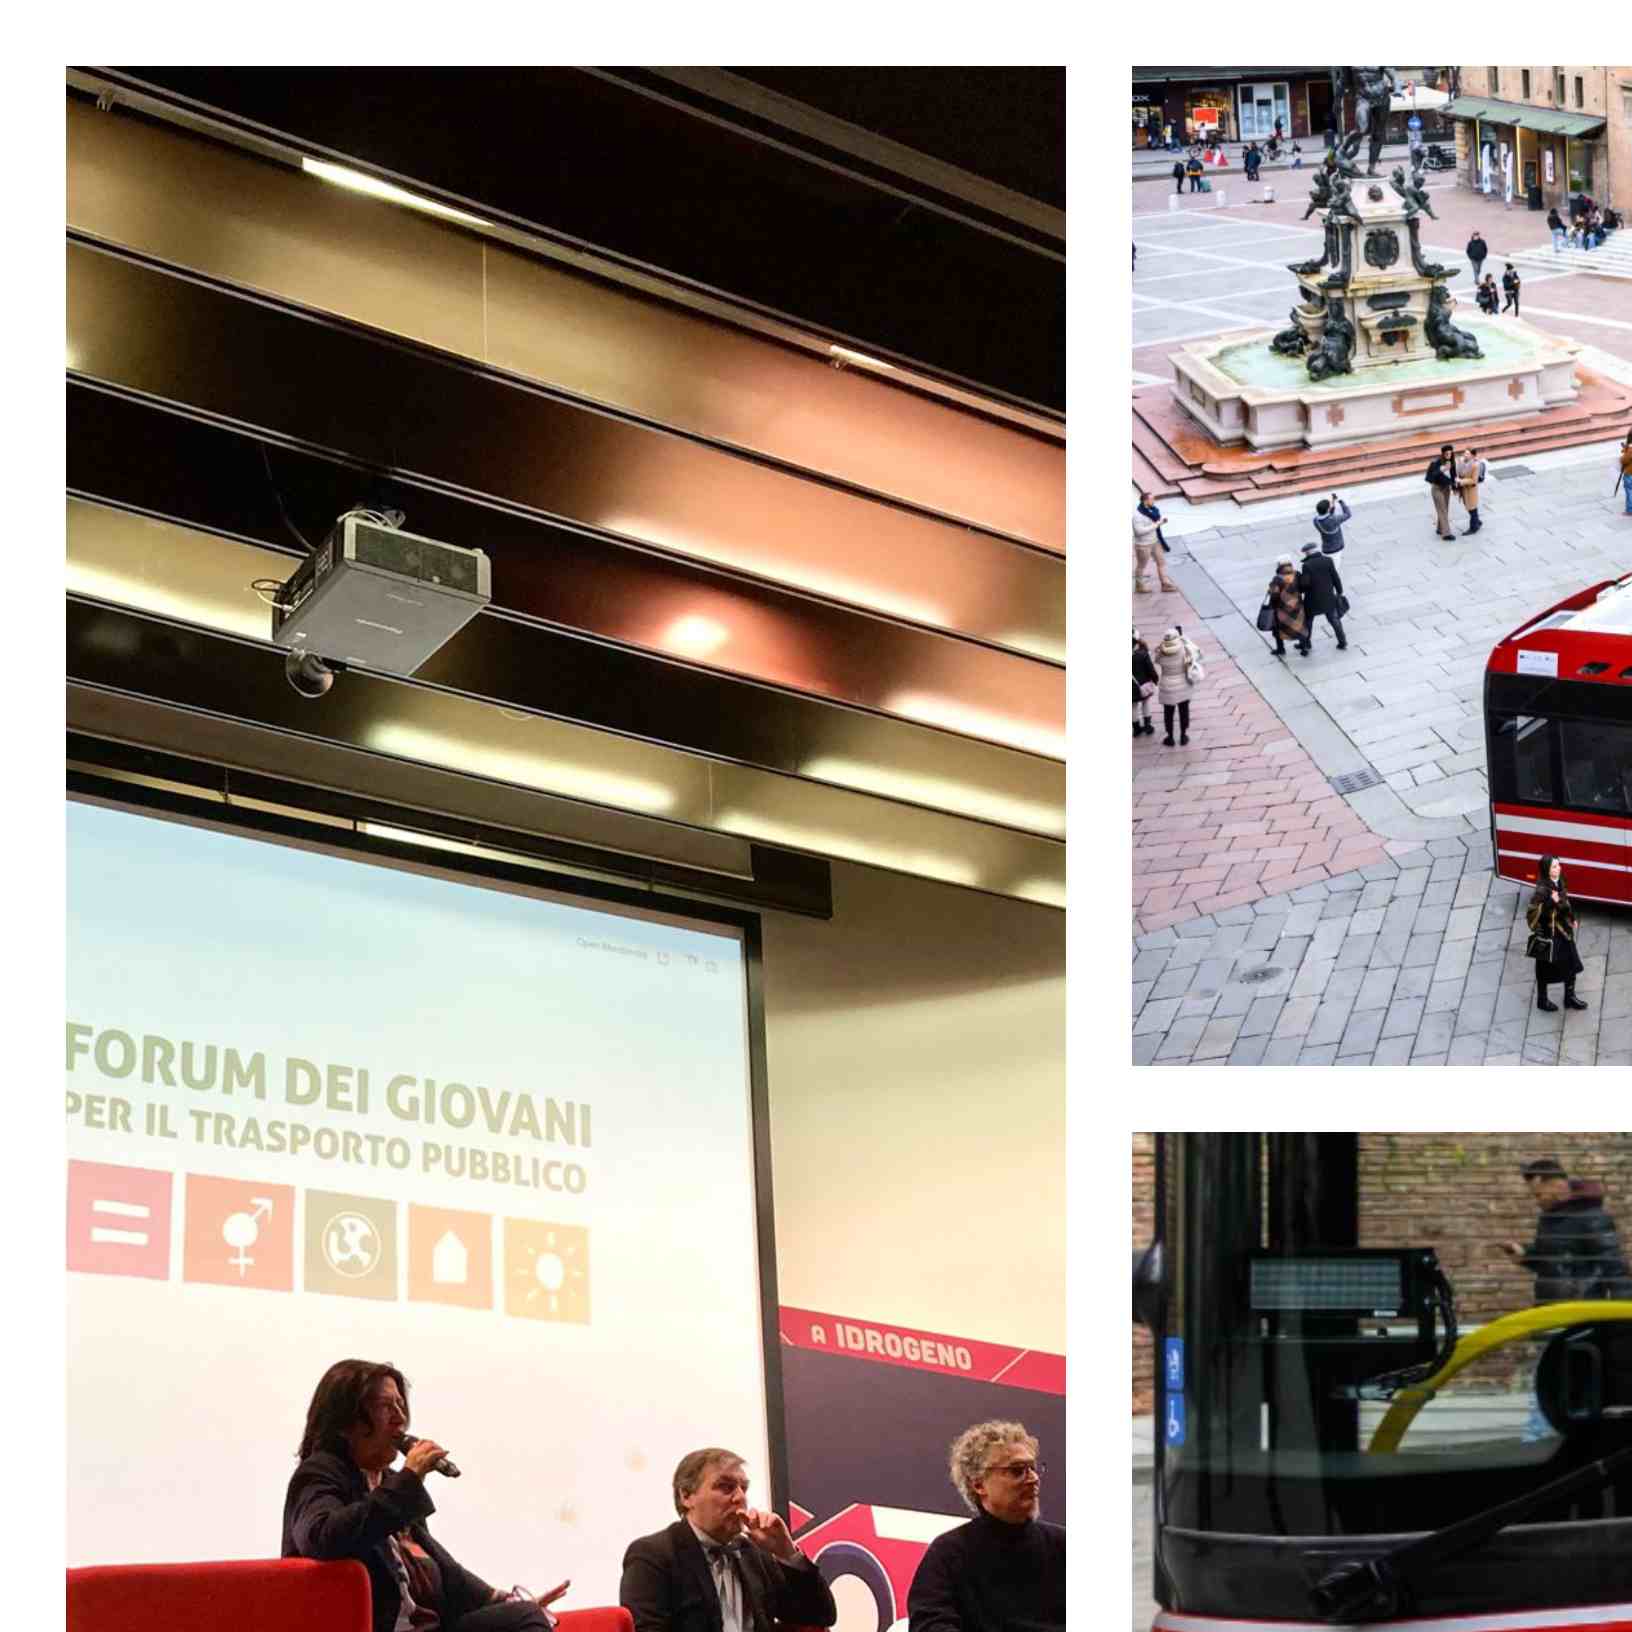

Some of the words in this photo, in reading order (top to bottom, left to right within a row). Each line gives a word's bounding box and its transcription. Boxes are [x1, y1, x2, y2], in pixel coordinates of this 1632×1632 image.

[66, 1022, 266, 1099] FORUM
[285, 1057, 369, 1115] DEI
[386, 1073, 592, 1148] GIOVANI
[66, 1091, 132, 1133] PER
[145, 1103, 177, 1138] IL
[189, 1109, 411, 1169] TRASPORTO
[422, 1142, 587, 1194] PUBBLICO
[835, 1323, 972, 1370] IDROGENO
